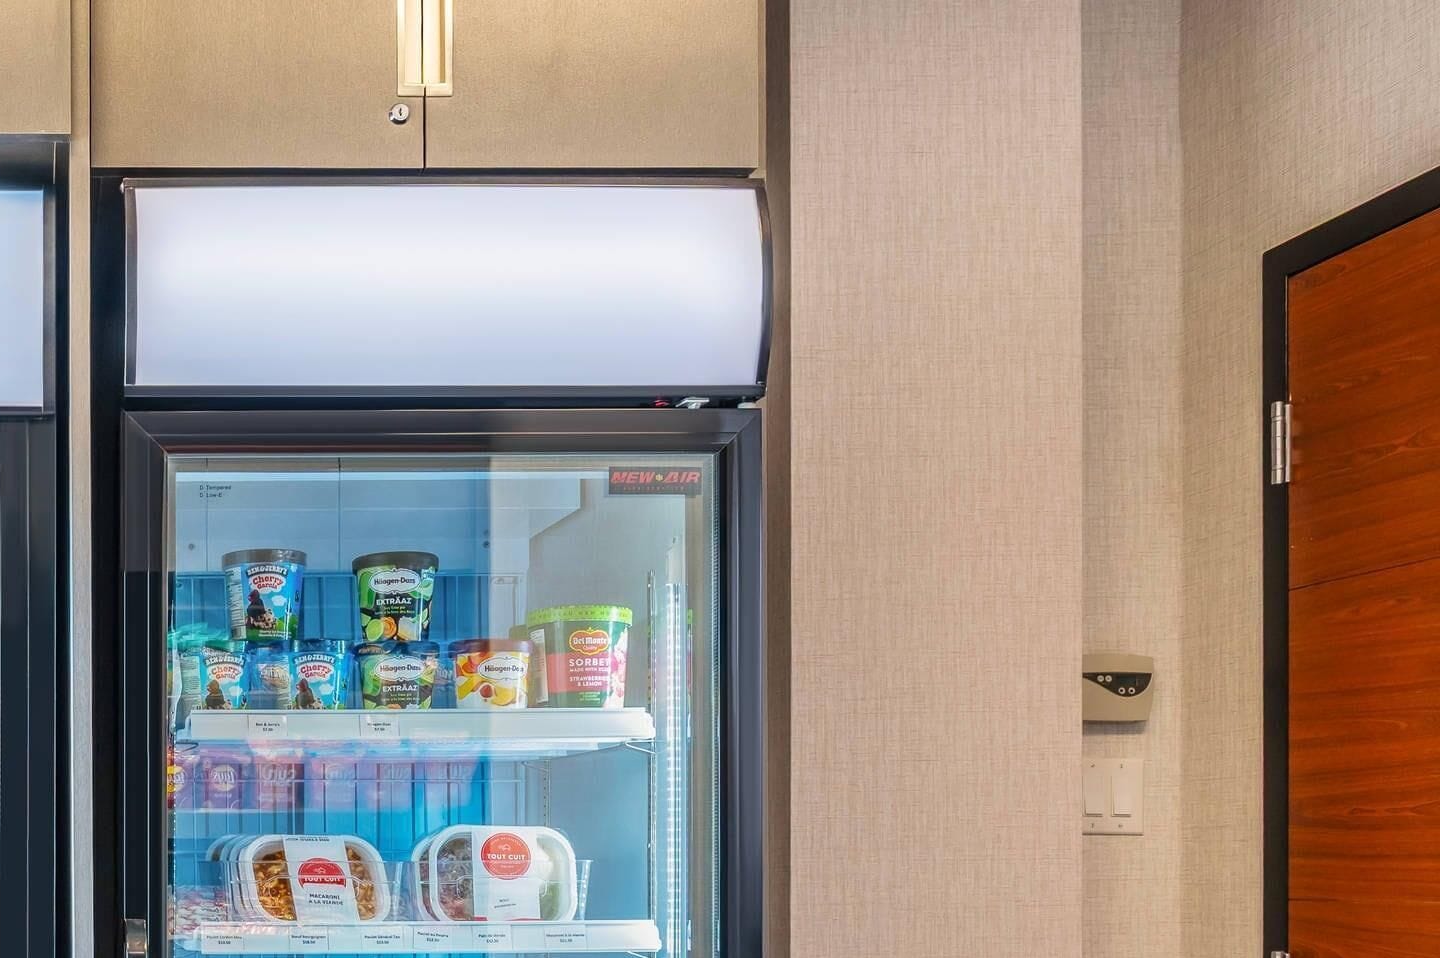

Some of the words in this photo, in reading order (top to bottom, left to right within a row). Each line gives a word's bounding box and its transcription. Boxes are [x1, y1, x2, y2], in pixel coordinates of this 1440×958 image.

[252, 576, 284, 586] Cherry
[573, 637, 585, 645] Del
[585, 637, 608, 645] Monte
[569, 657, 610, 667] SORBET
[211, 666, 241, 675] Cherry
[300, 665, 330, 675] Cherry
[484, 664, 525, 673] Häagen-Das
[487, 853, 506, 861] TOUT
